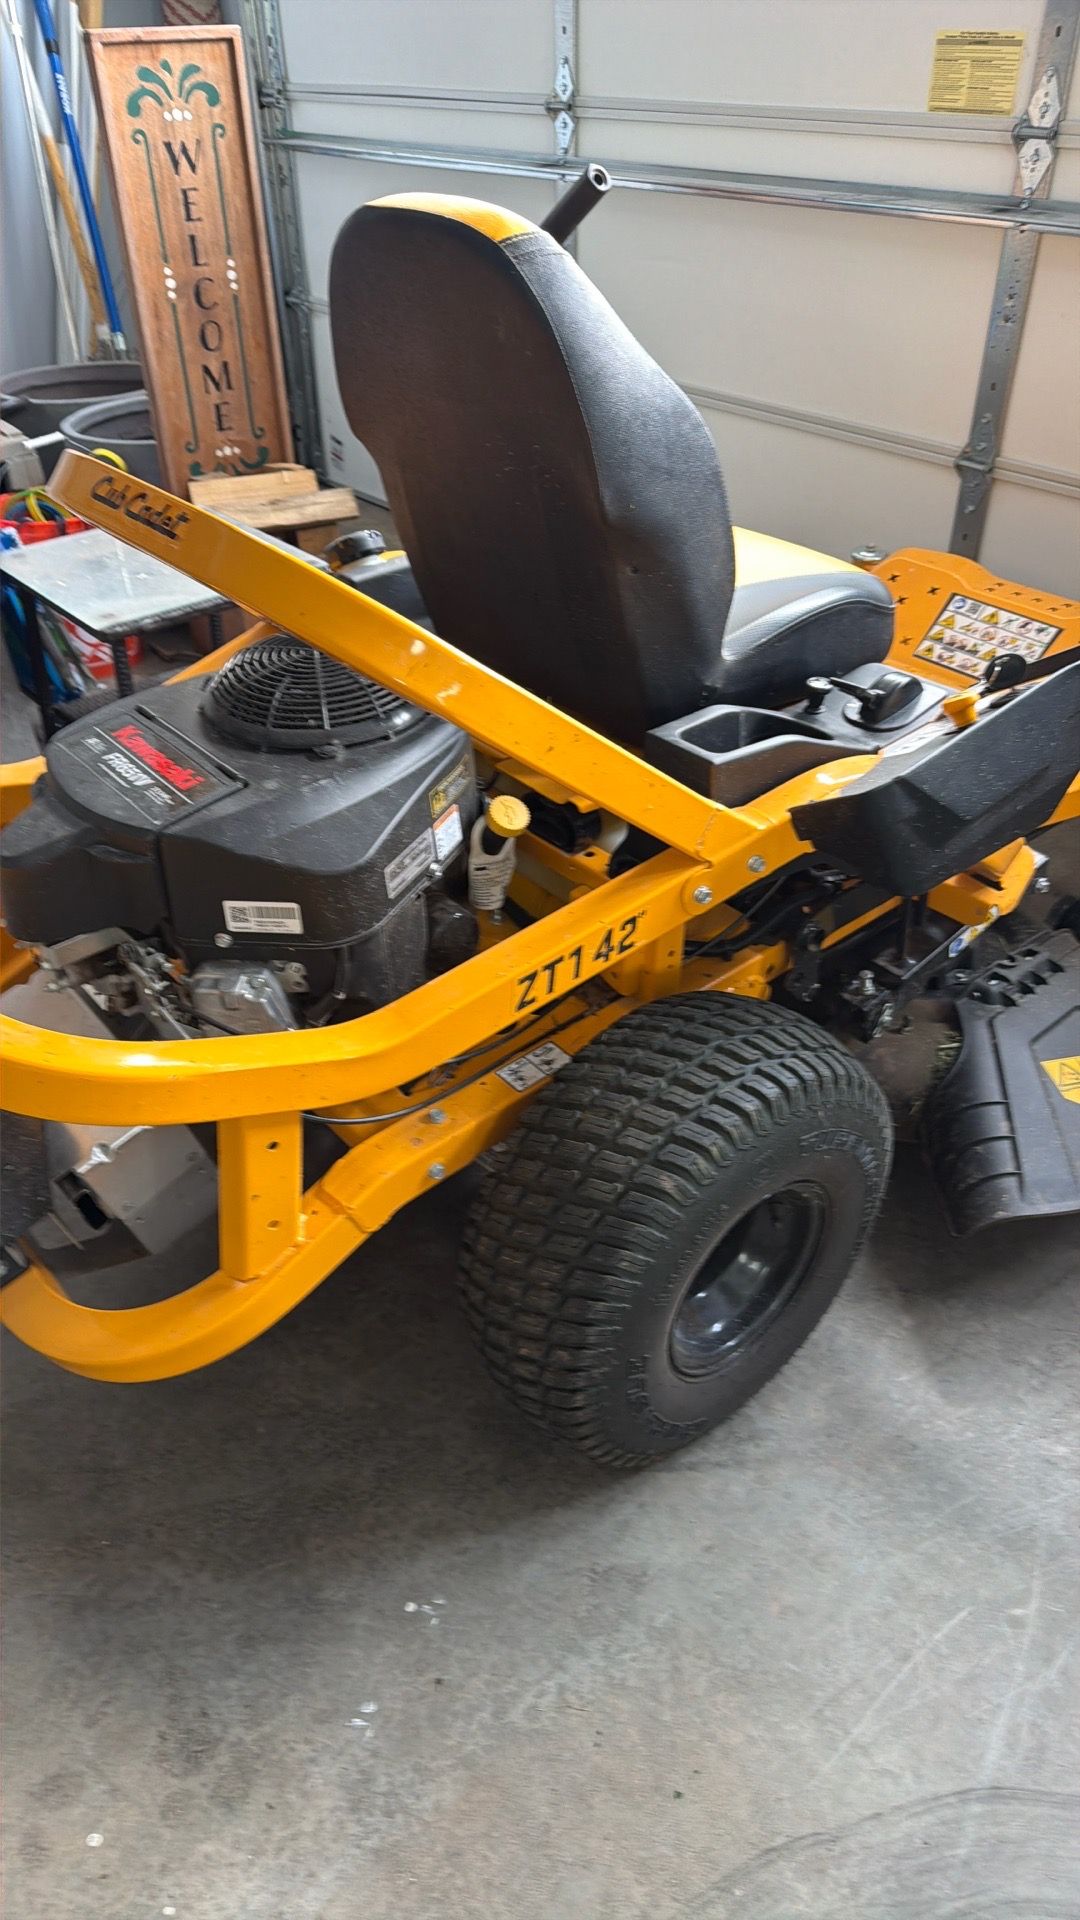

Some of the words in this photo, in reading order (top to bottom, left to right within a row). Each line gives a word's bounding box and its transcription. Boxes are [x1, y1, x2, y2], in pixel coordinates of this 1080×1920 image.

[162, 138, 235, 432] WELCOME
[90, 475, 131, 510] Cub
[124, 492, 190, 540] Cadet
[111, 723, 206, 791] Kawasaki
[516, 944, 583, 1011] ZT1
